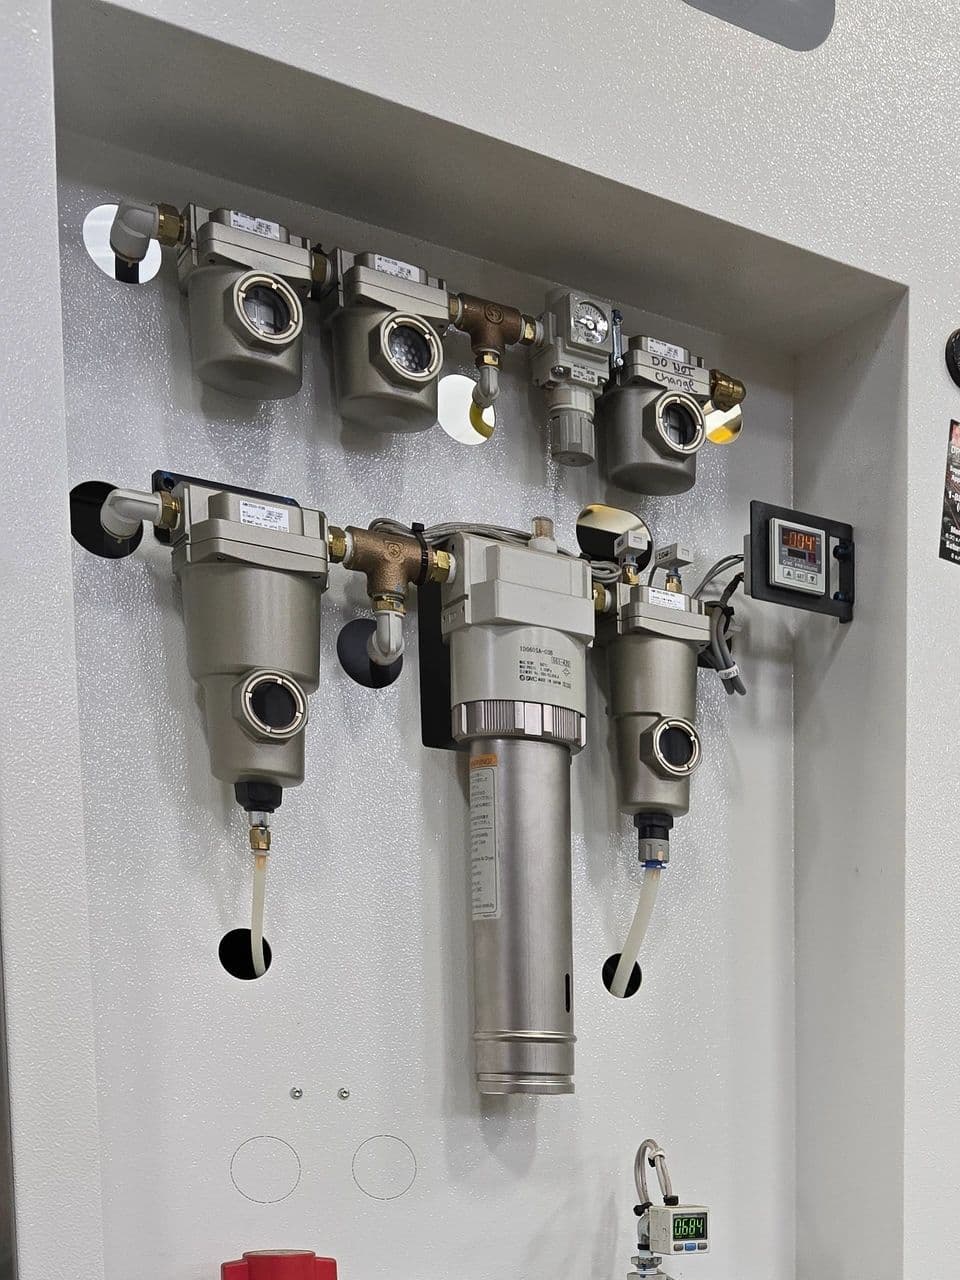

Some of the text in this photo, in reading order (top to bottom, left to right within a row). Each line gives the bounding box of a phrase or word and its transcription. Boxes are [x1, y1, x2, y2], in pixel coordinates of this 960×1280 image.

[652, 356, 695, 377] DO NOT
[655, 372, 698, 393] change
